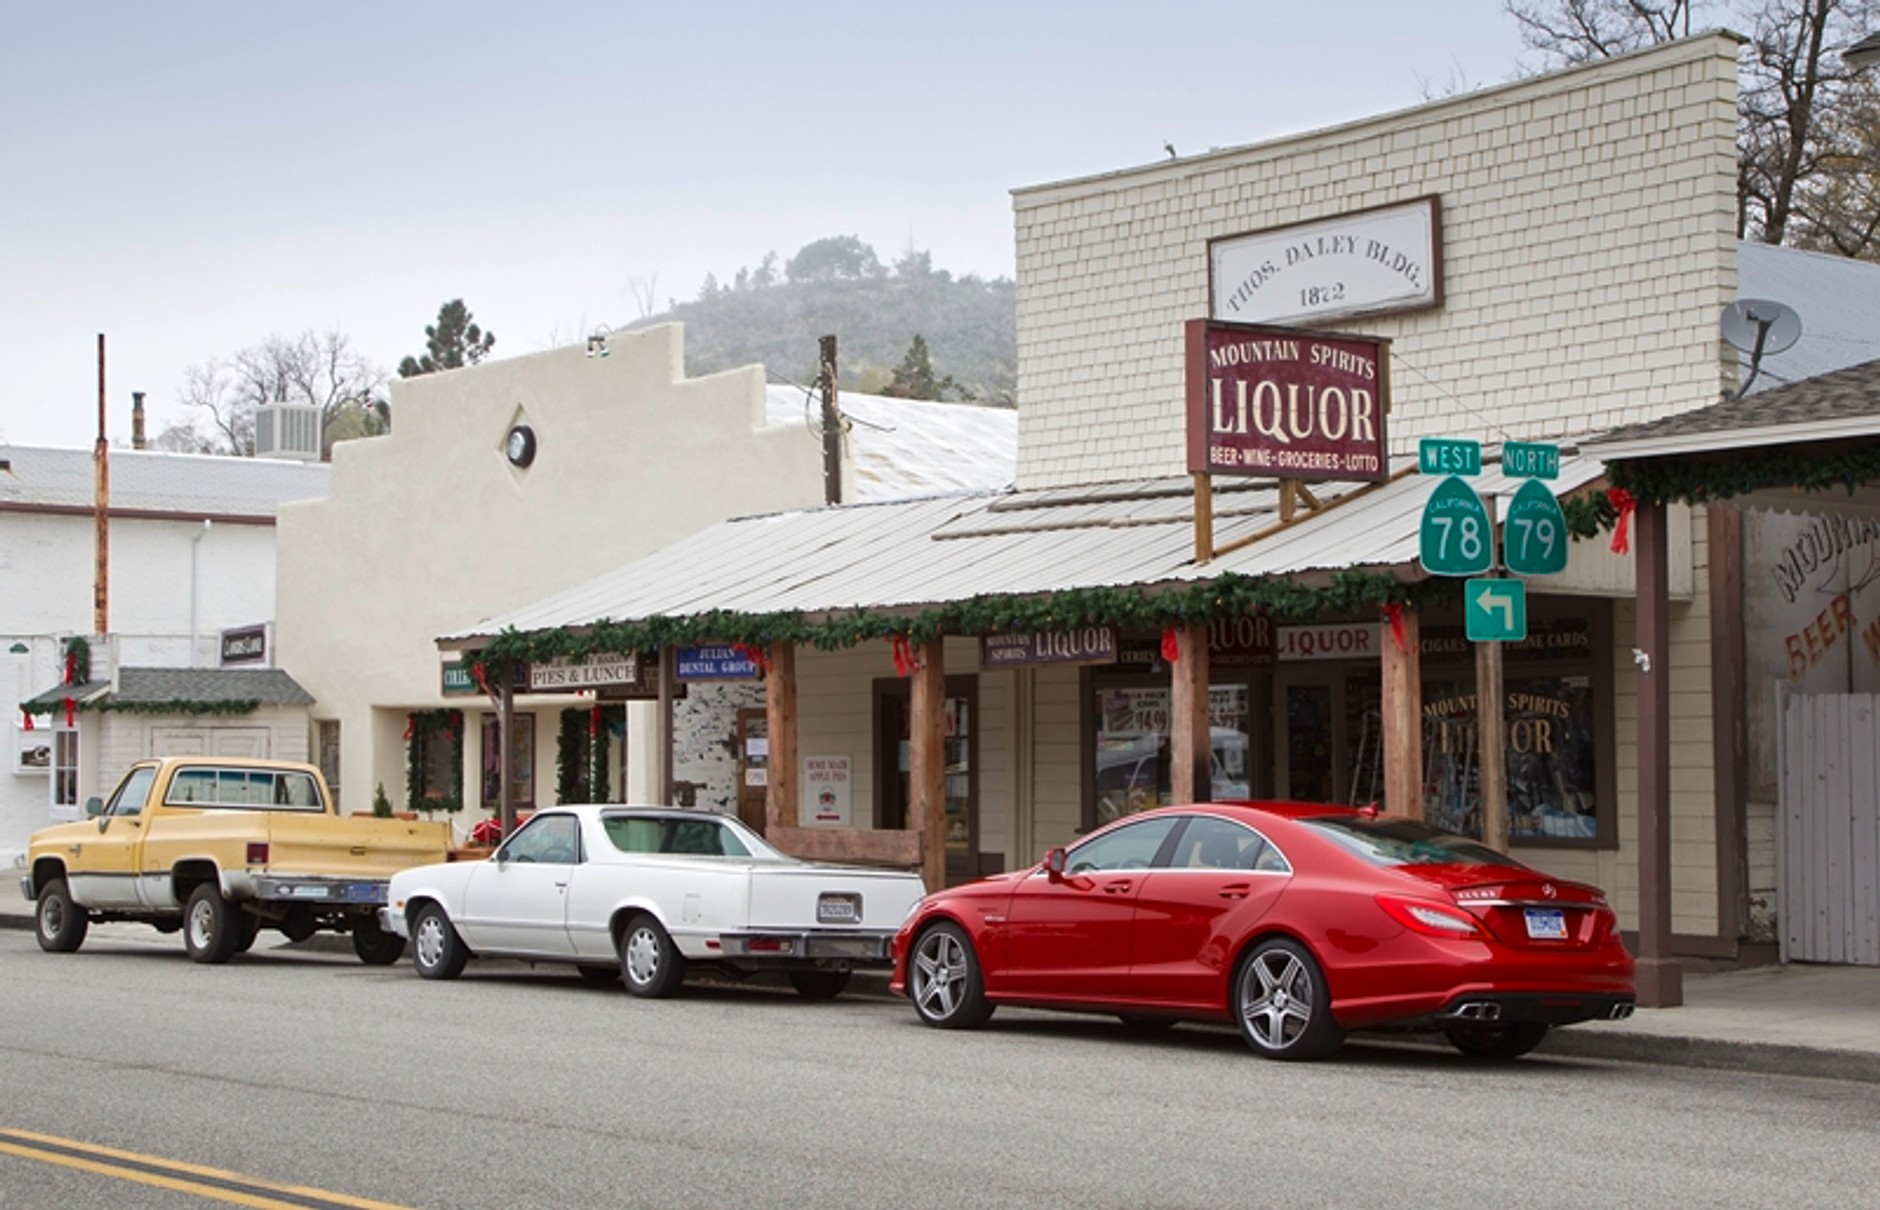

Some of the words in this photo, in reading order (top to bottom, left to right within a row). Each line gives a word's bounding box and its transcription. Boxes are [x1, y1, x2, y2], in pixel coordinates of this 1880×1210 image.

[1227, 260, 1281, 312] THOS.
[1285, 235, 1360, 267] DALEY
[1365, 239, 1421, 289] BLDG.
[1300, 282, 1345, 308] 1872
[1210, 340, 1299, 369] MOUNTAIN
[1310, 343, 1375, 380] SPIRITS
[1211, 378, 1376, 443] LIQUOR
[1425, 446, 1473, 469] WEST
[1504, 449, 1557, 472] NORTH
[1428, 498, 1480, 514] CALIFORNIA
[1431, 516, 1482, 560] 78
[1513, 518, 1555, 560] 79
[1036, 627, 1111, 658] LIQUOR
[1208, 616, 1269, 651] QUOR
[1279, 628, 1370, 657] IQUOR
[1546, 632, 1588, 649] CARDS
[1785, 592, 1858, 682] BEER
[699, 648, 735, 660] JULIAN
[991, 648, 1026, 660] SPIRITS
[532, 669, 566, 686] PIES
[569, 669, 581, 683] &
[584, 664, 635, 683] LUNCH
[679, 661, 716, 674] DENTAL
[1423, 694, 1477, 718] MOUNT
[1508, 692, 1570, 718] SPIRITS
